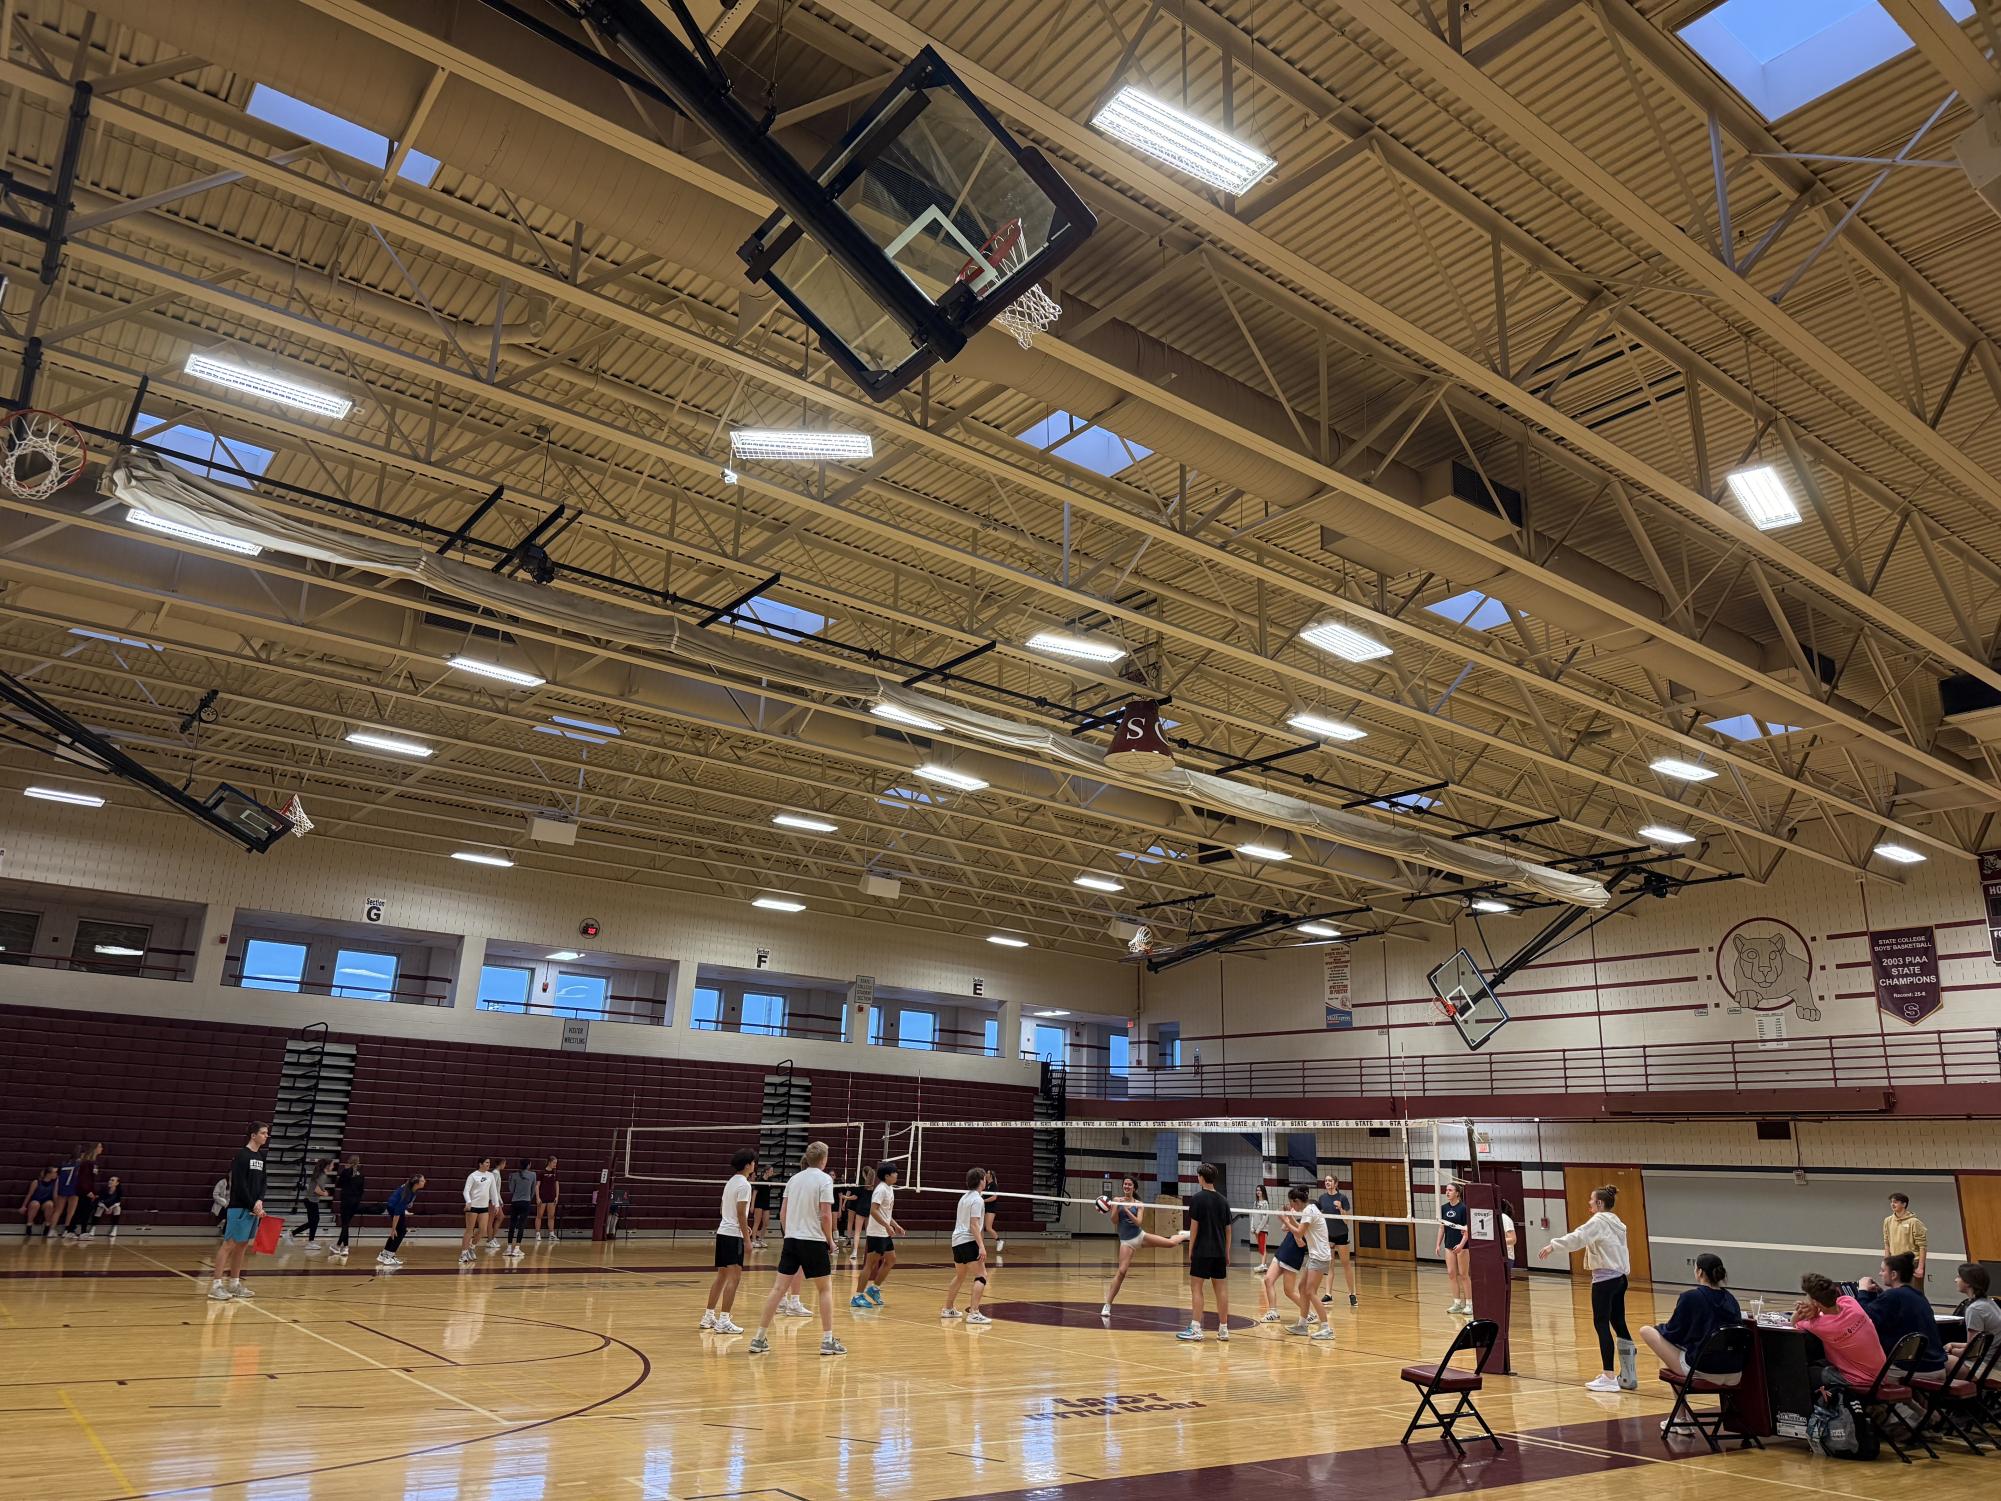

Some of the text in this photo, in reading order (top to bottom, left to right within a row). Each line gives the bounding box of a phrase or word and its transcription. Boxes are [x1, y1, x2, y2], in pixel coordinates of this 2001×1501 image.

[1126, 718, 1146, 740] S
[366, 906, 382, 922] G
[1893, 942, 1932, 950] BASKETBALL
[757, 954, 768, 968] F
[1905, 955, 1928, 964] PIAA
[1891, 966, 1921, 975] STATE
[1879, 975, 1937, 986] CHAMPIONS
[973, 983, 983, 996] E
[61, 1167, 75, 1186] 7
[1479, 1219, 1484, 1230] 1
